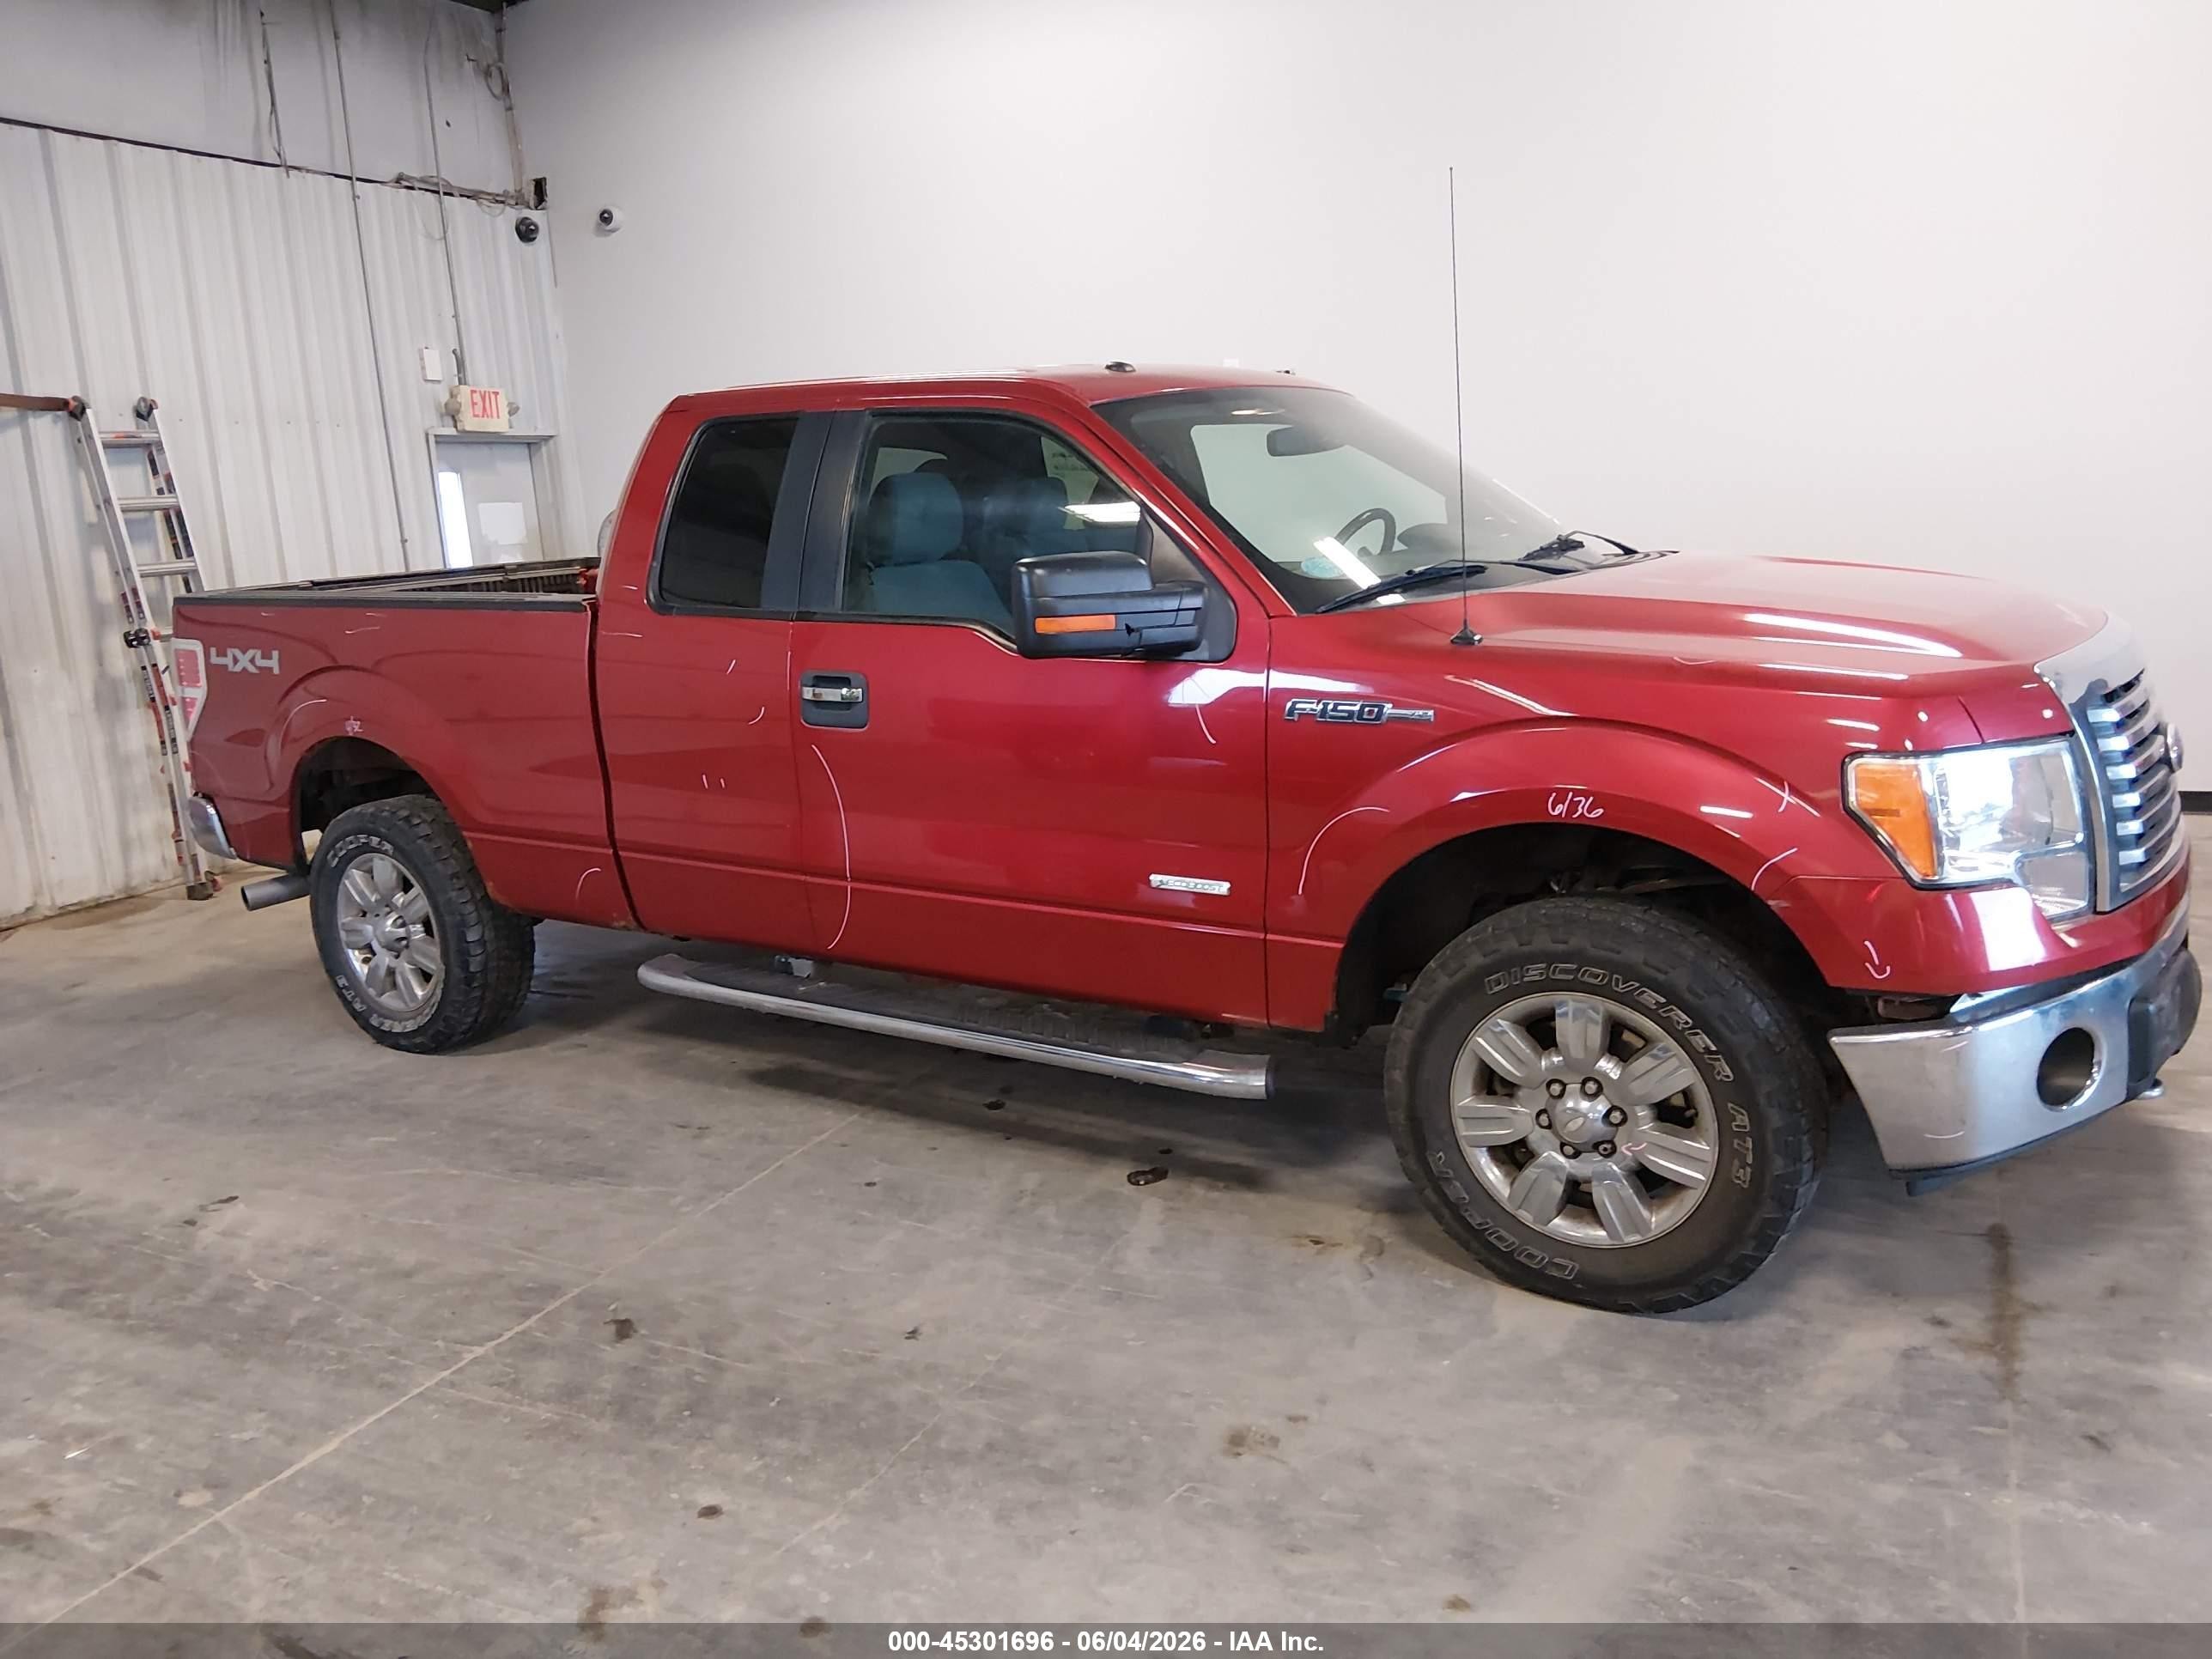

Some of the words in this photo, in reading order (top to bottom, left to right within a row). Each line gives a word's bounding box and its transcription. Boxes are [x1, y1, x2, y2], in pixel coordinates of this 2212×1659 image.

[470, 389, 500, 419] EXIT
[1485, 963, 1735, 1082] DISCOVERER
[1728, 1102, 1753, 1188] AT3
